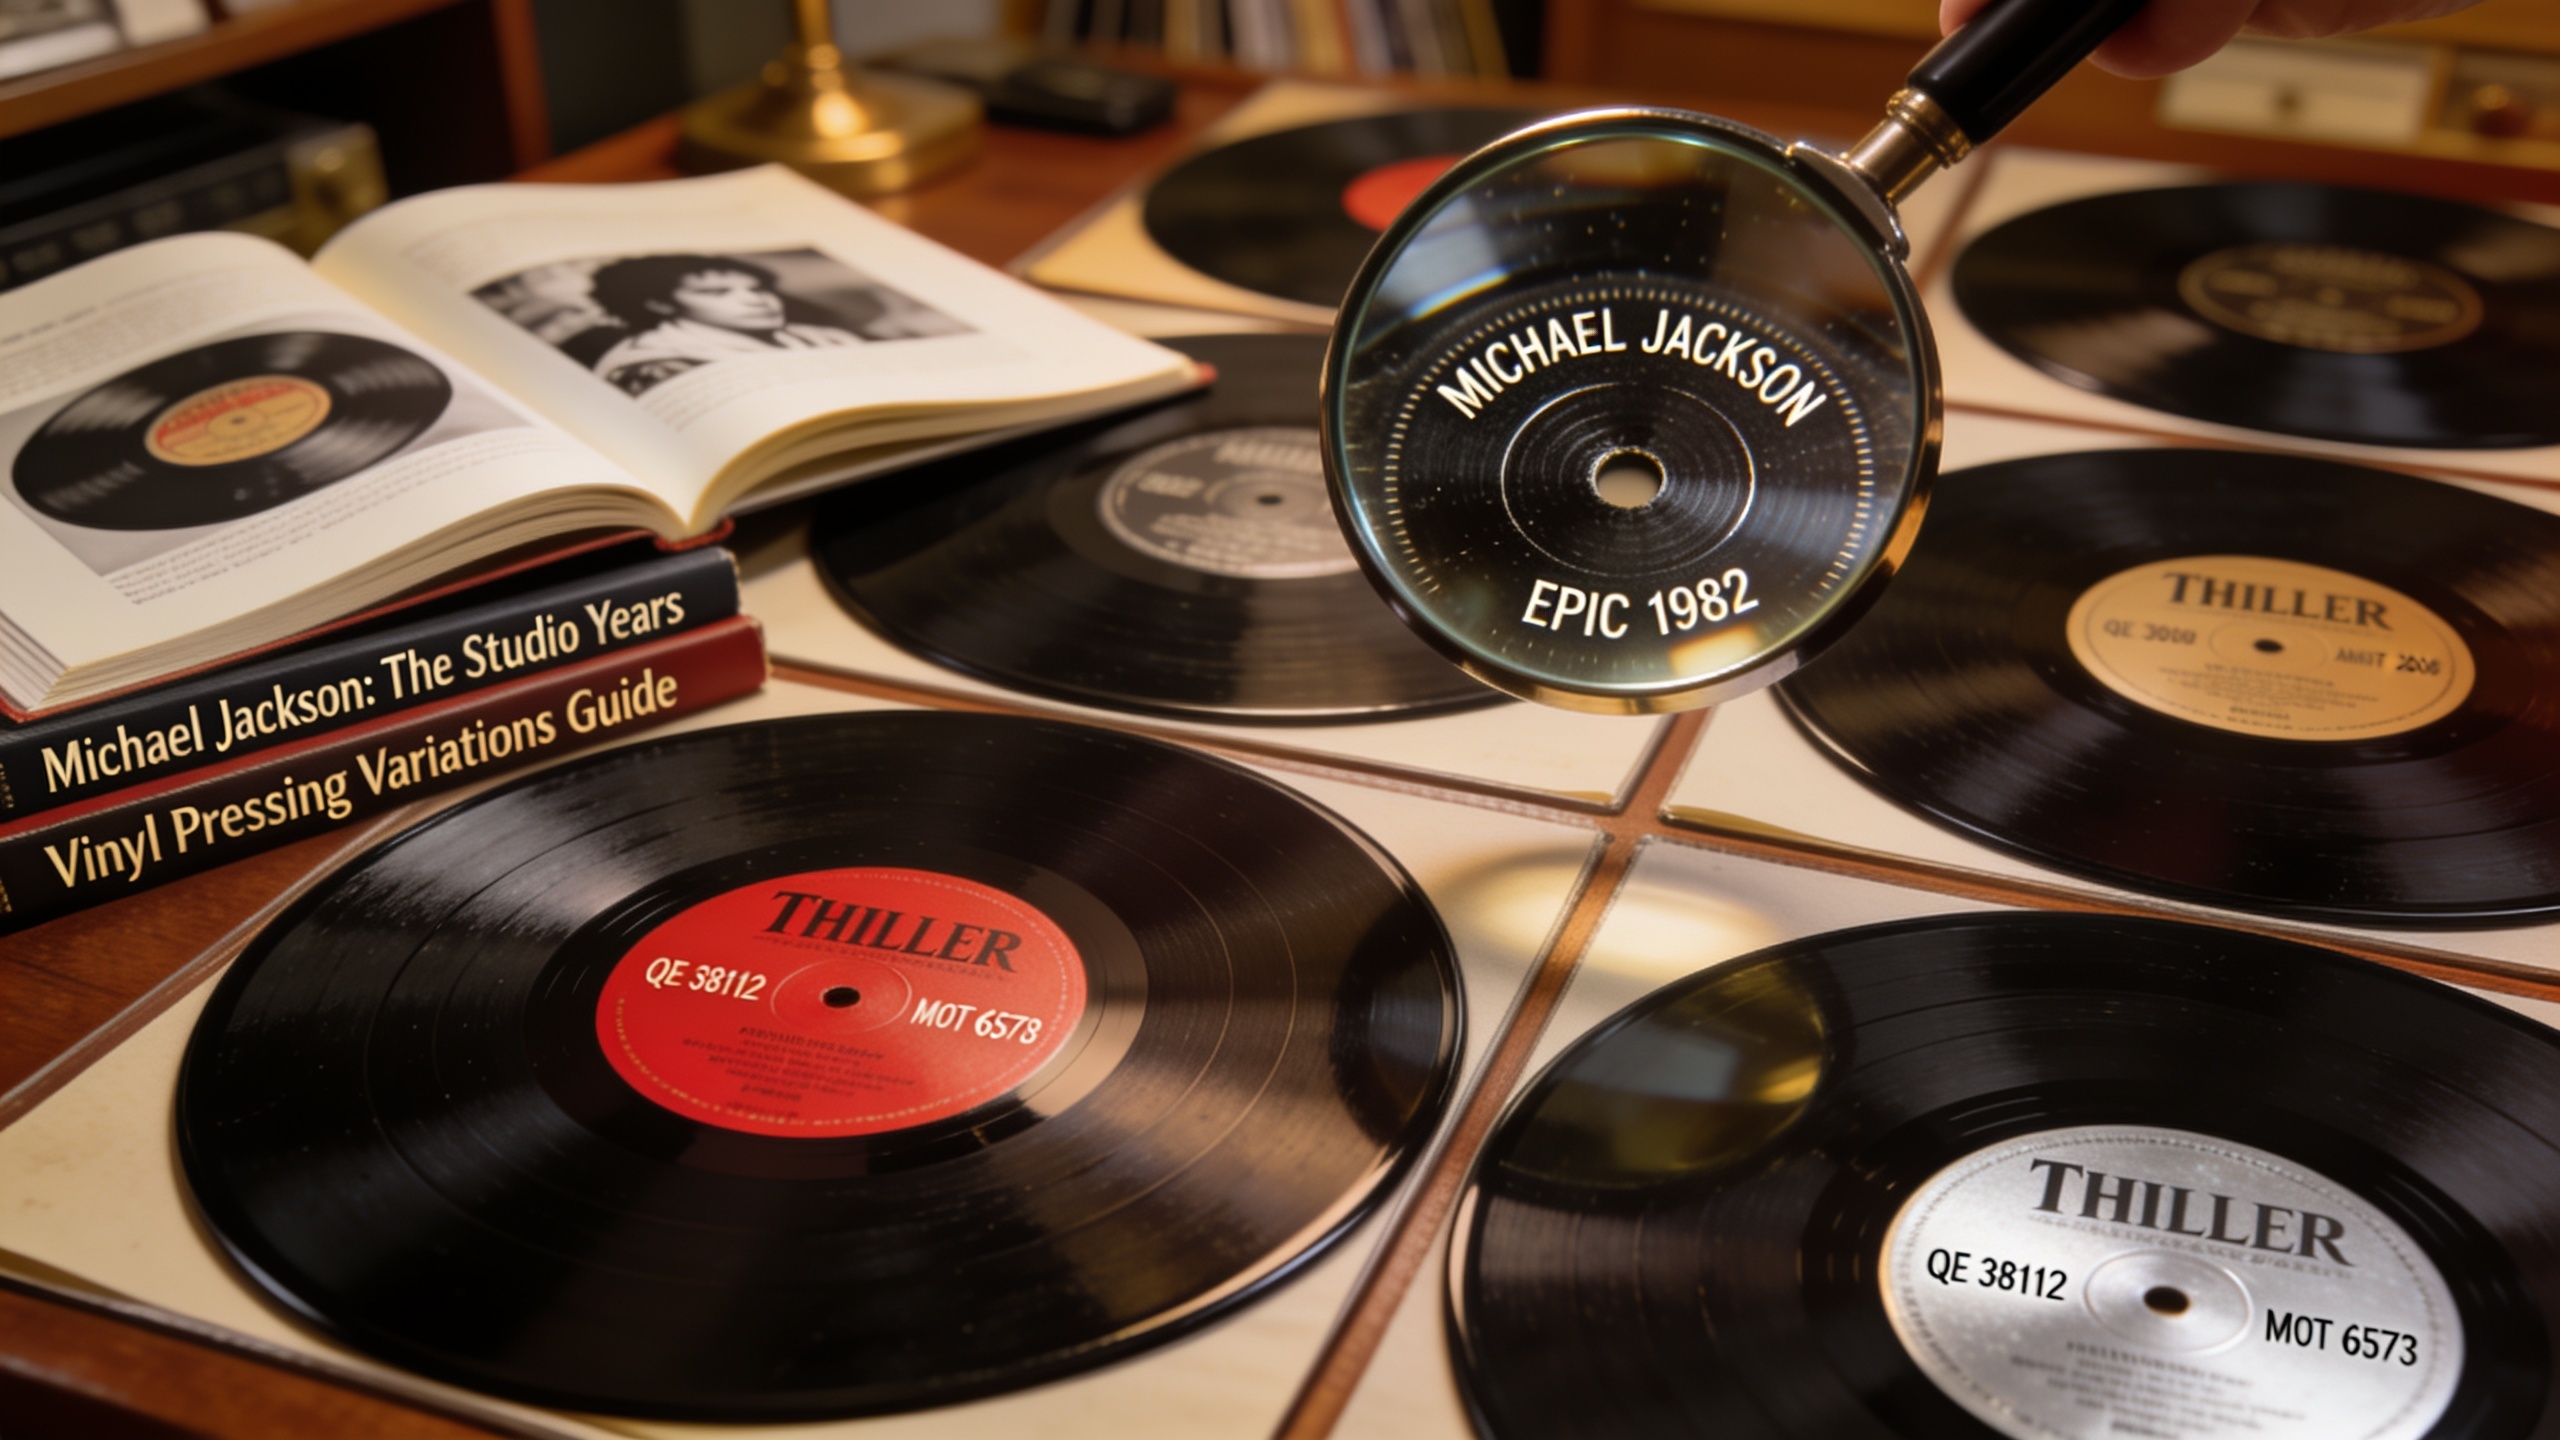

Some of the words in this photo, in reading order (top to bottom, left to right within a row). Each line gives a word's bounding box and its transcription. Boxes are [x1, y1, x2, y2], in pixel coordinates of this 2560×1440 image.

[1437, 307, 1627, 420] MICHAEL
[1641, 308, 1827, 428] JACKSON
[1521, 578, 1629, 639] EPIC
[1647, 567, 1759, 636] 1982
[2162, 571, 2395, 631] THILLER
[41, 704, 204, 793] Michael
[214, 675, 376, 753] Jackson:
[380, 647, 455, 700] The
[462, 614, 580, 678] Studio
[584, 591, 685, 645] Years
[44, 813, 162, 889] Vinyl
[171, 769, 352, 854] Pressing
[355, 710, 556, 797] Variations
[566, 667, 679, 733] Guide
[763, 890, 1023, 973] THILLER
[645, 956, 690, 989] QE
[688, 964, 767, 1001] 38112
[910, 997, 977, 1032] MOT
[974, 1008, 1043, 1045] 6578
[2030, 1158, 2356, 1267] THILLER
[1926, 1248, 1971, 1285] QE
[1978, 1257, 2068, 1301] 38112
[2265, 1308, 2334, 1350] MOT
[2342, 1323, 2418, 1367] 6573
